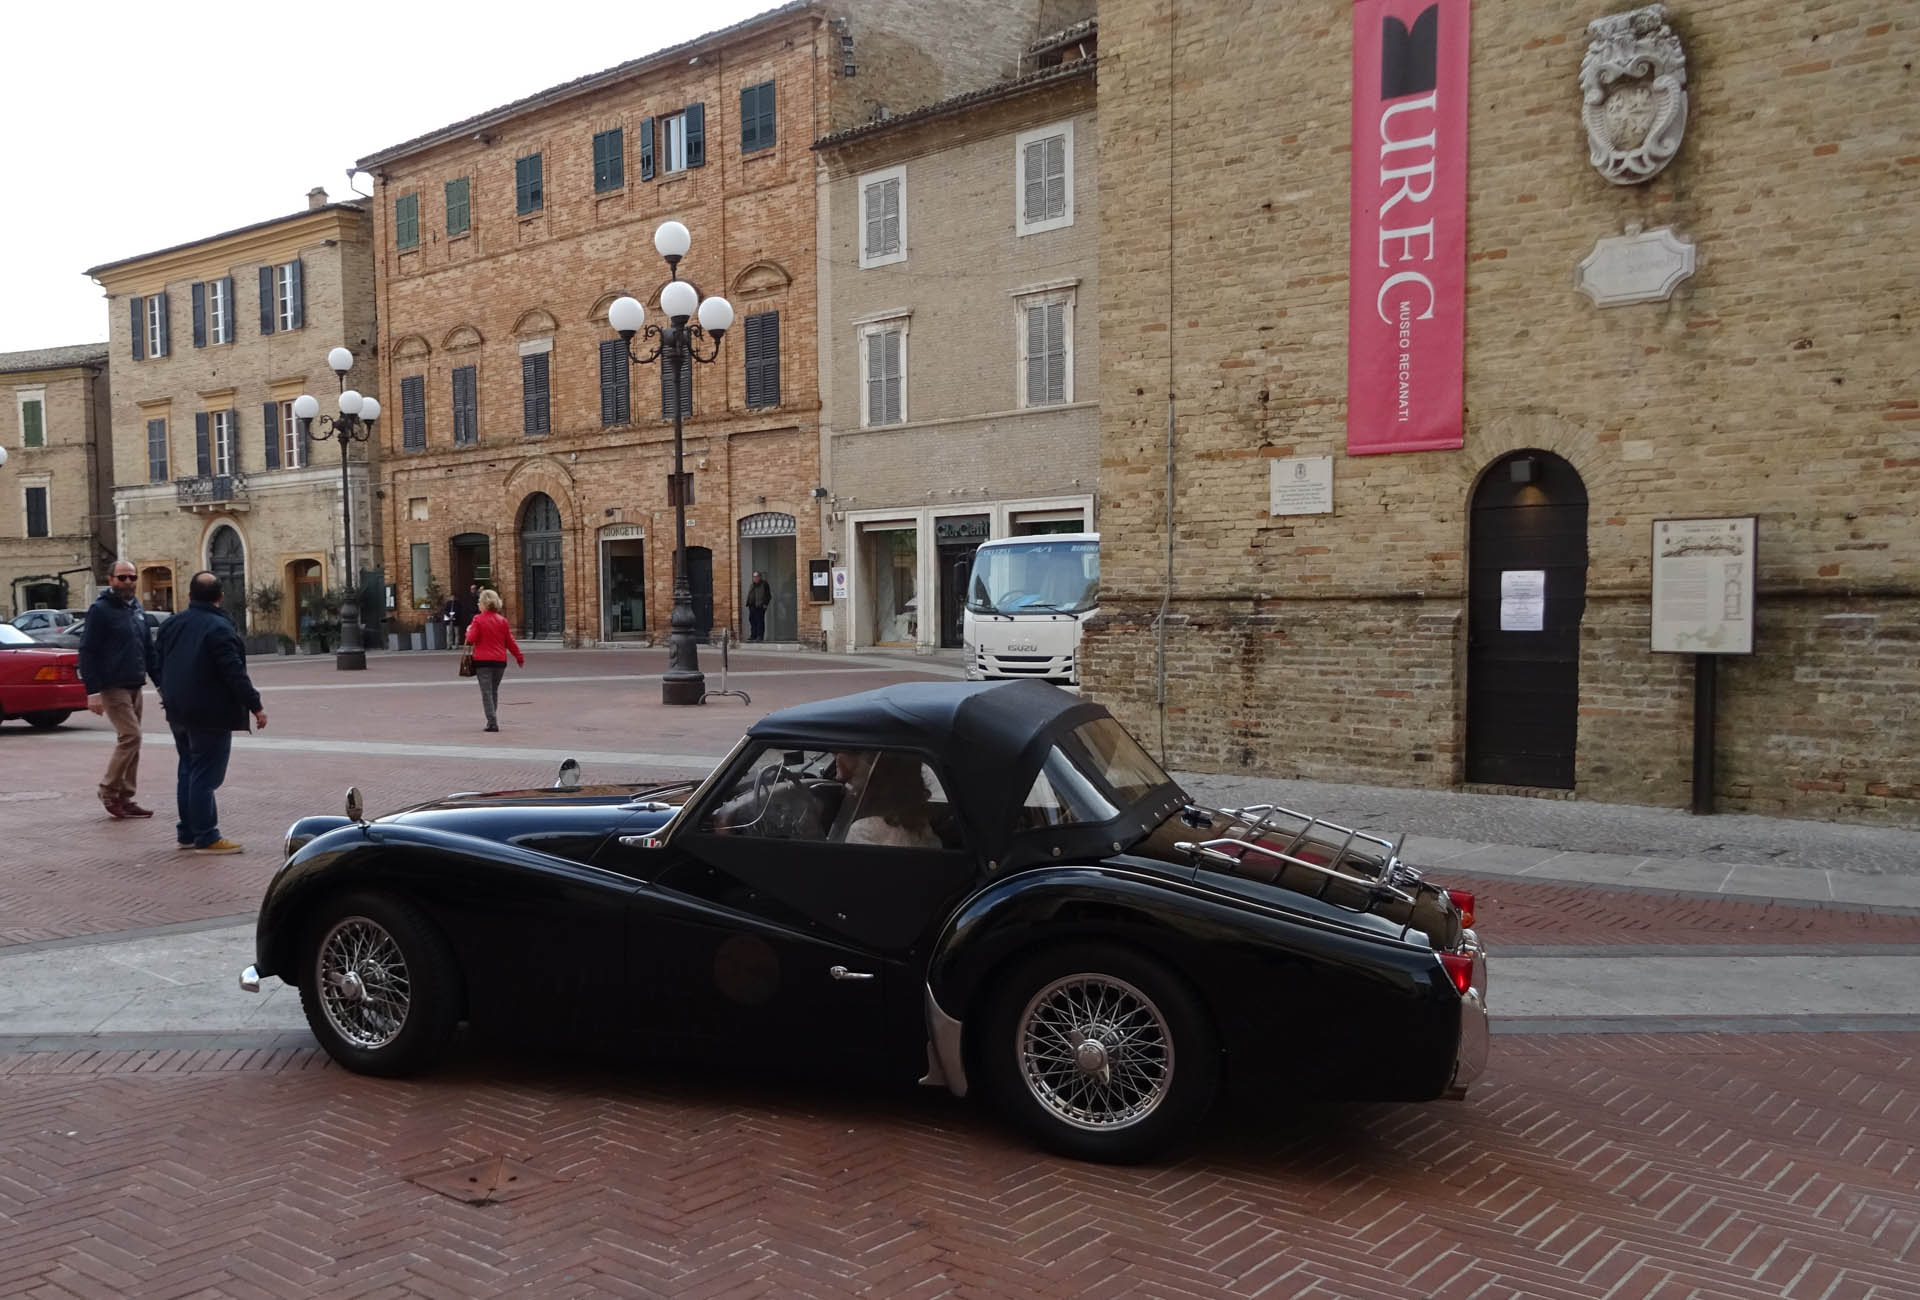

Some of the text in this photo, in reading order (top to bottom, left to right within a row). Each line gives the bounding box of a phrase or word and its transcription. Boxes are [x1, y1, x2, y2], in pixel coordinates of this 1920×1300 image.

[1399, 301, 1410, 422] MUSEO RECANATI
[1007, 644, 1038, 653] ISUZU
